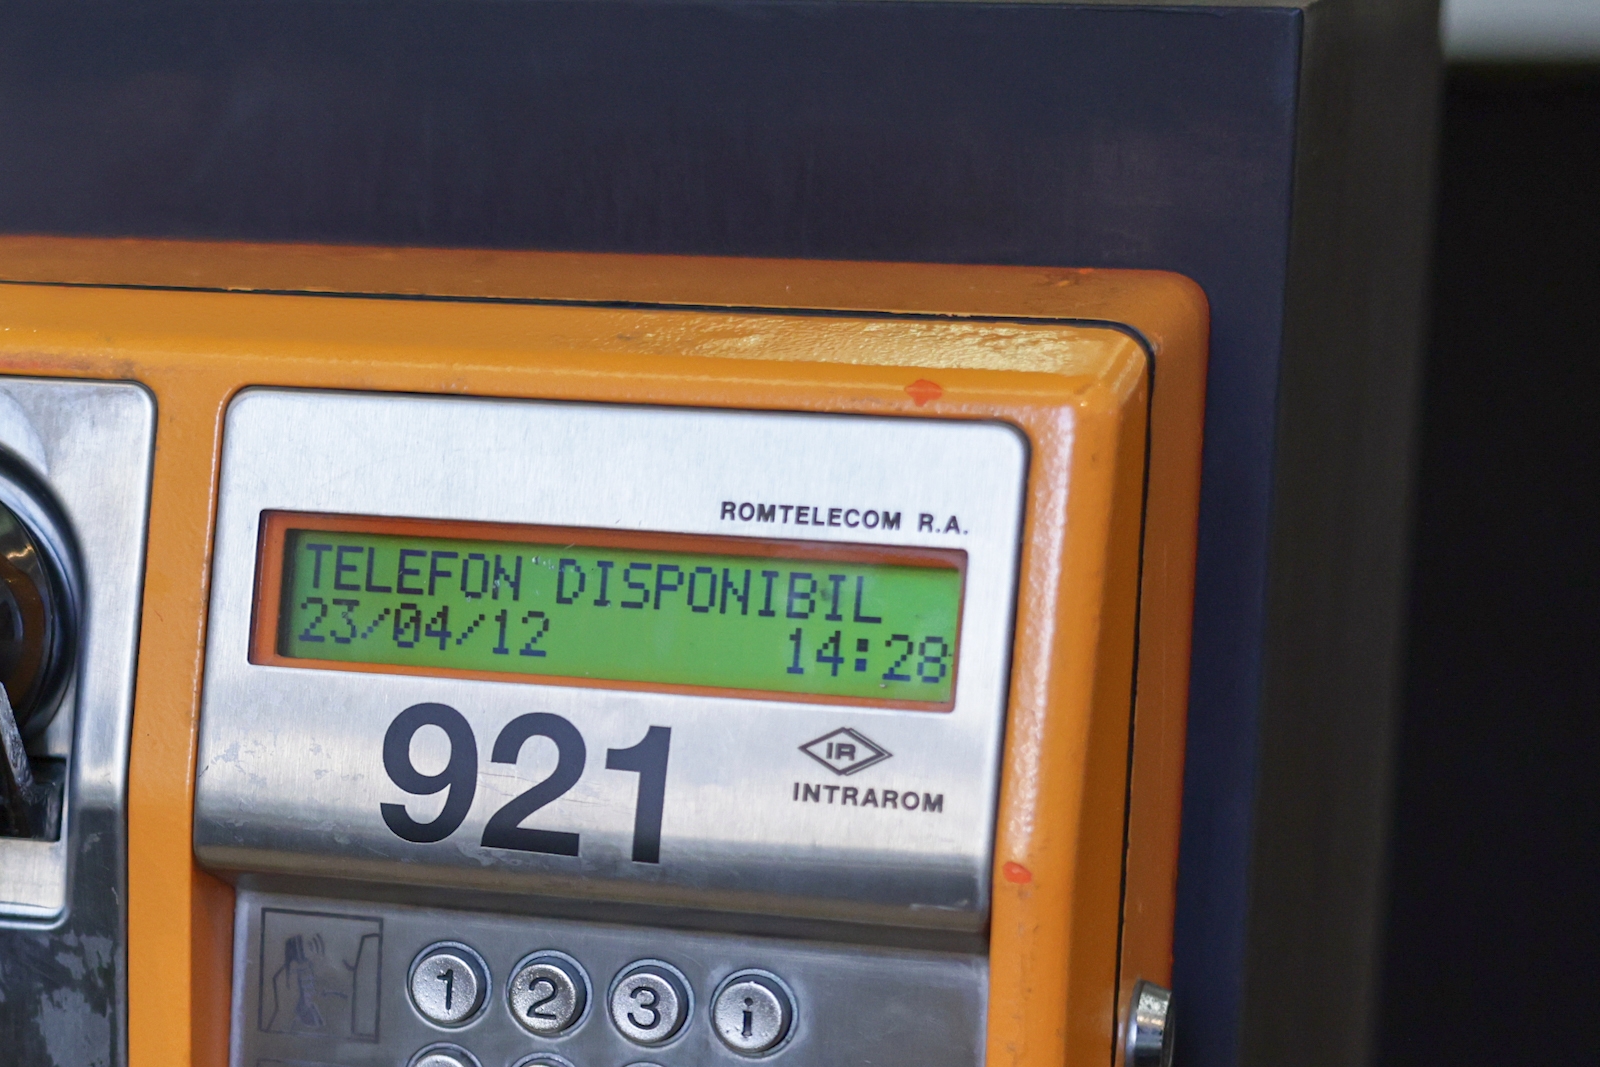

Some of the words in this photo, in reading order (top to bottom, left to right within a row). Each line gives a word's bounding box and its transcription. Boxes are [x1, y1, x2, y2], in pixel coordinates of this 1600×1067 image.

[721, 502, 902, 531] ROMTELECOM
[917, 514, 970, 535] R.A.
[307, 544, 523, 600] TELEFON
[556, 558, 882, 623] DISPONIBIL
[298, 598, 550, 657] 23/04/12
[786, 627, 949, 683] 14:28
[825, 742, 857, 761] IR
[379, 702, 672, 864] 921
[793, 782, 945, 812] INTRAROM
[436, 968, 454, 1011] 1
[526, 978, 558, 1019] 2
[628, 987, 662, 1030] 3
[741, 997, 755, 1037] i
